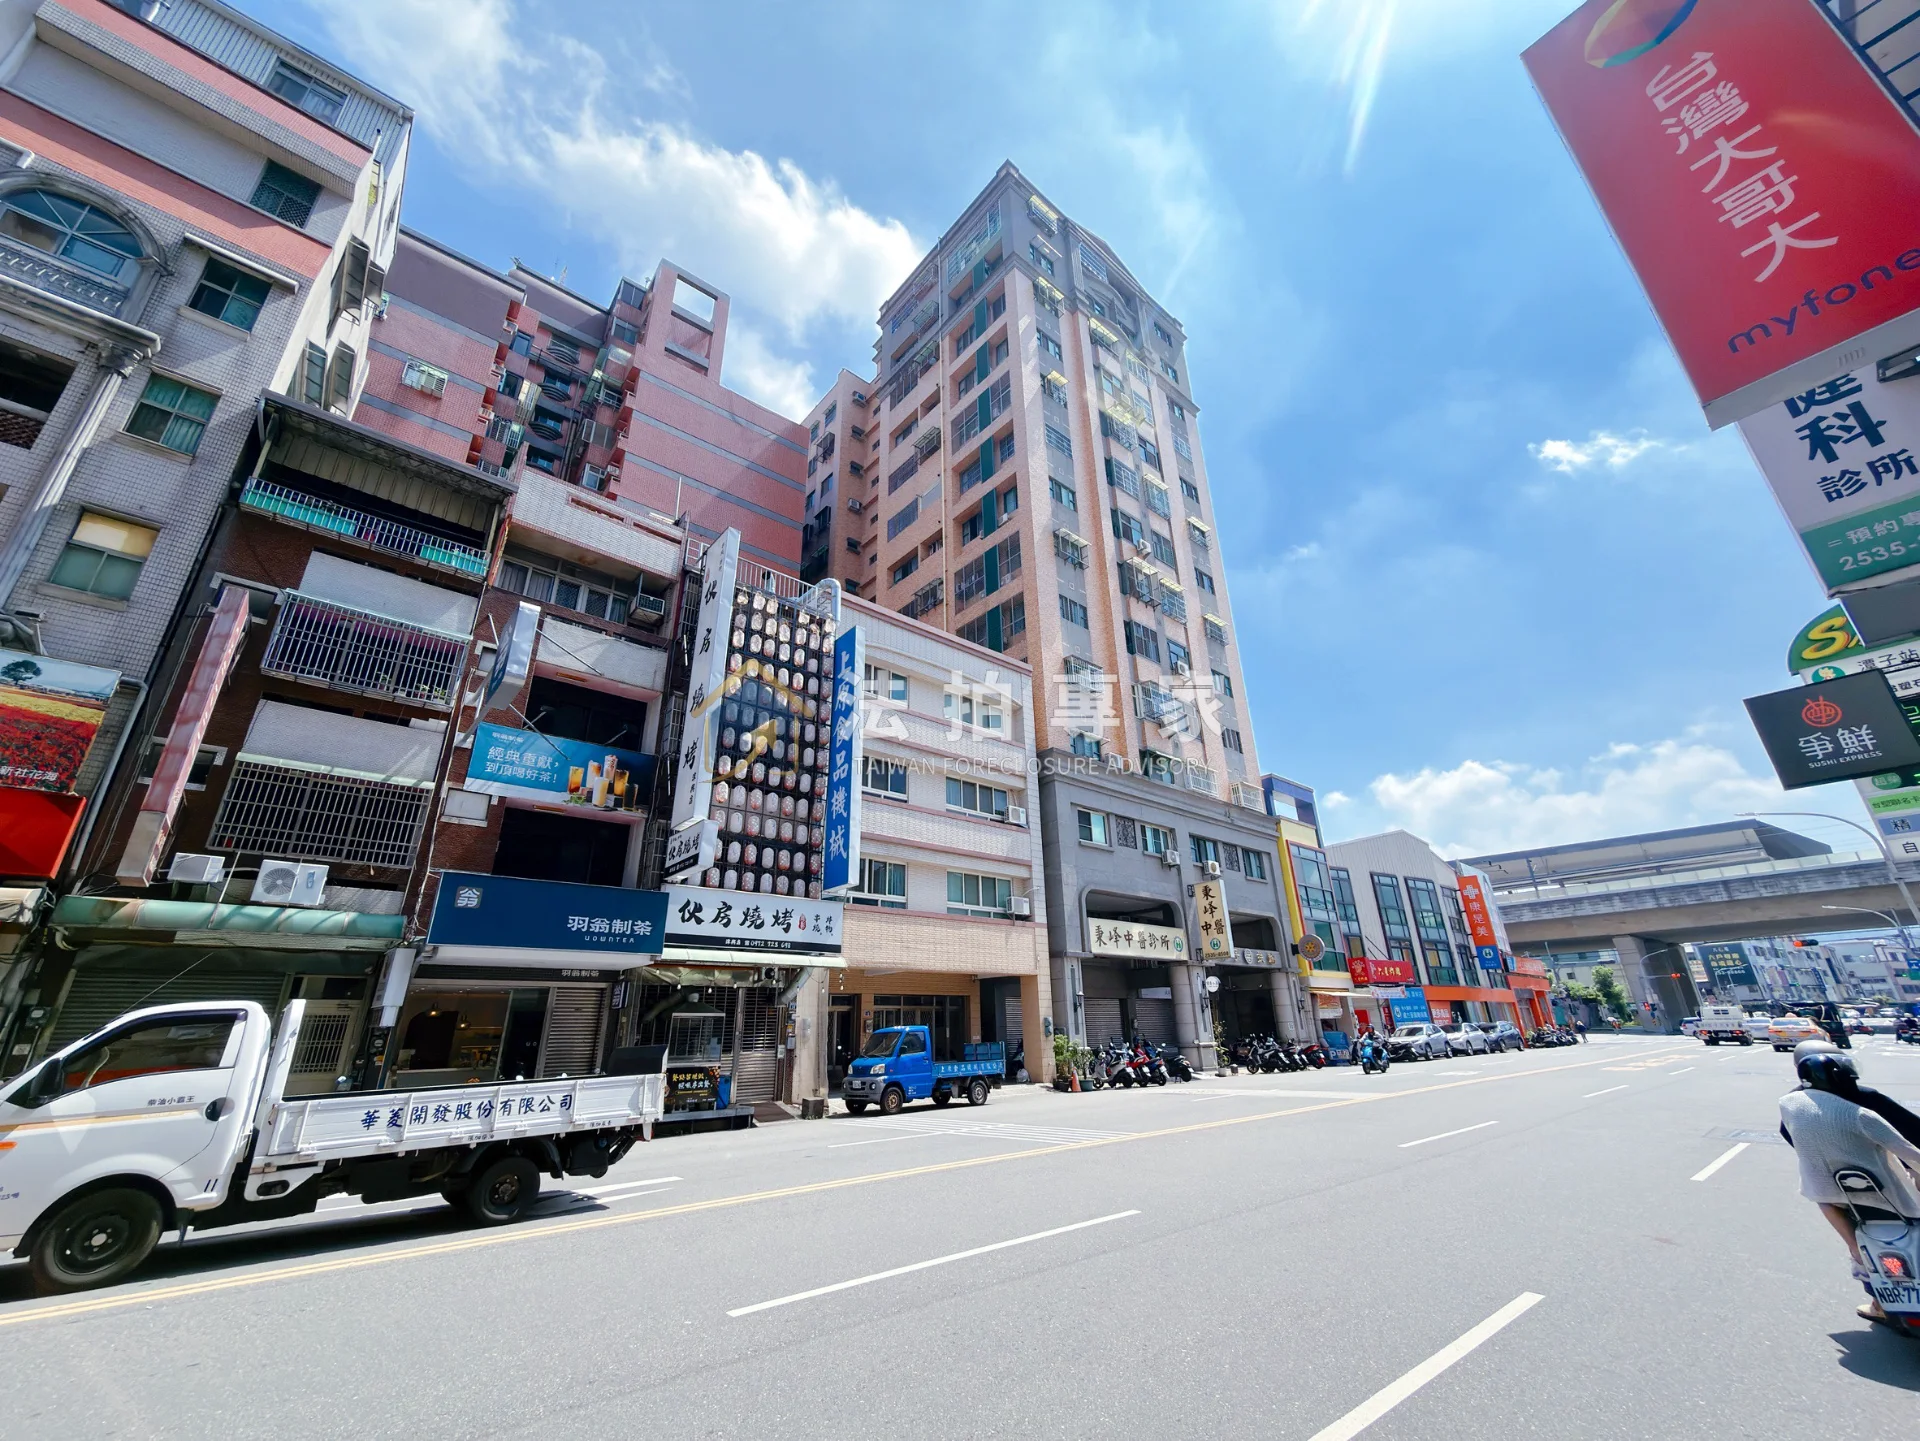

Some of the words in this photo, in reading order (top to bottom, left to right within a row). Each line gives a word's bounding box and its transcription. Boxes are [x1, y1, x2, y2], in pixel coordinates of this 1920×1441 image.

[1645, 50, 1839, 283] 台灣大哥大
[1727, 248, 1920, 354] myfone
[1816, 448, 1920, 503] 診所
[828, 650, 853, 861] 上原食品機械
[1798, 724, 1878, 760] 爭鮮
[1808, 758, 1838, 769] SUSHI
[1839, 750, 1883, 763] EXPRESS
[1902, 841, 1919, 853] 自
[567, 915, 653, 936] 羽翁制茶
[678, 898, 795, 934] 伙房燒烤
[1469, 901, 1489, 936] 康是美
[360, 1094, 574, 1131] 華菱開發股份有限公司
